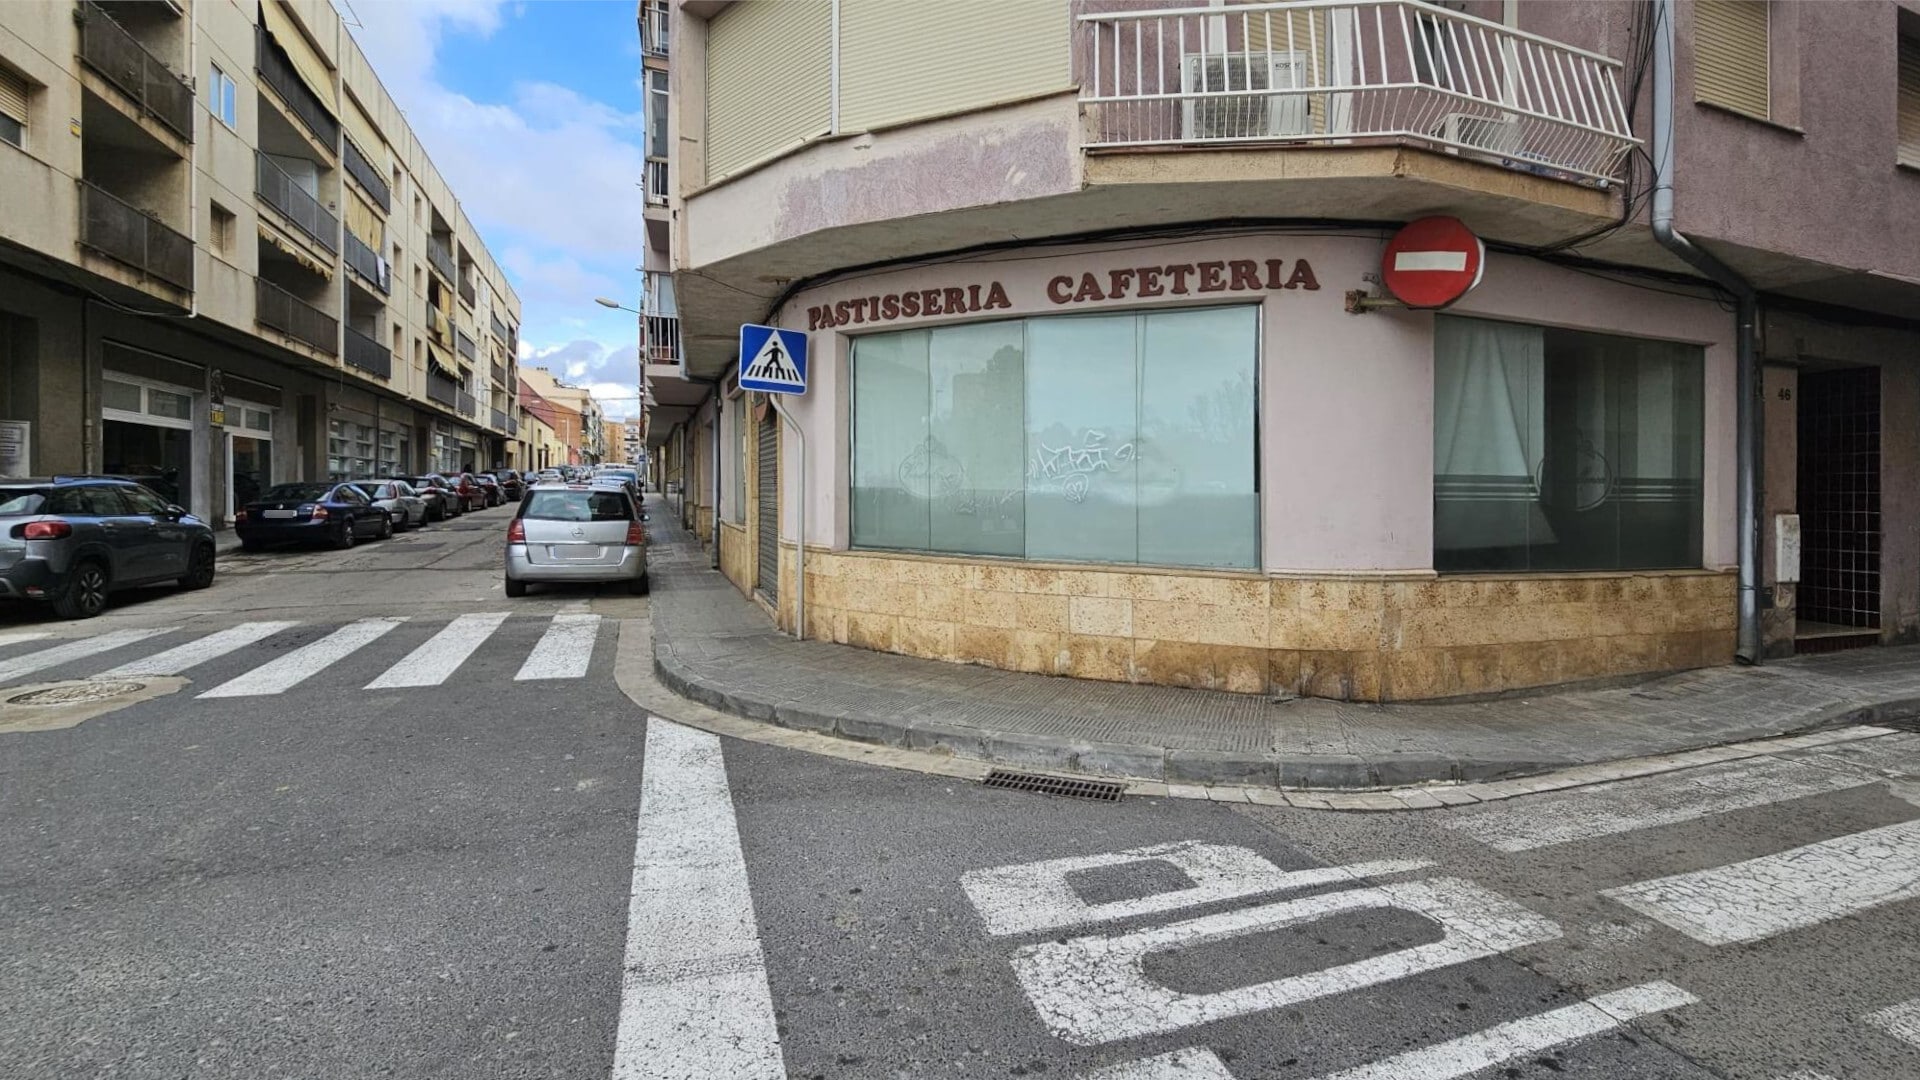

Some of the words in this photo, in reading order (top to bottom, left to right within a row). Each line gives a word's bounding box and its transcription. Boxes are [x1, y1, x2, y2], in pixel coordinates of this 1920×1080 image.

[807, 281, 1012, 331] PASTISSERIA
[1047, 259, 1321, 304] CAFETERIA
[1778, 388, 1791, 400] 46
